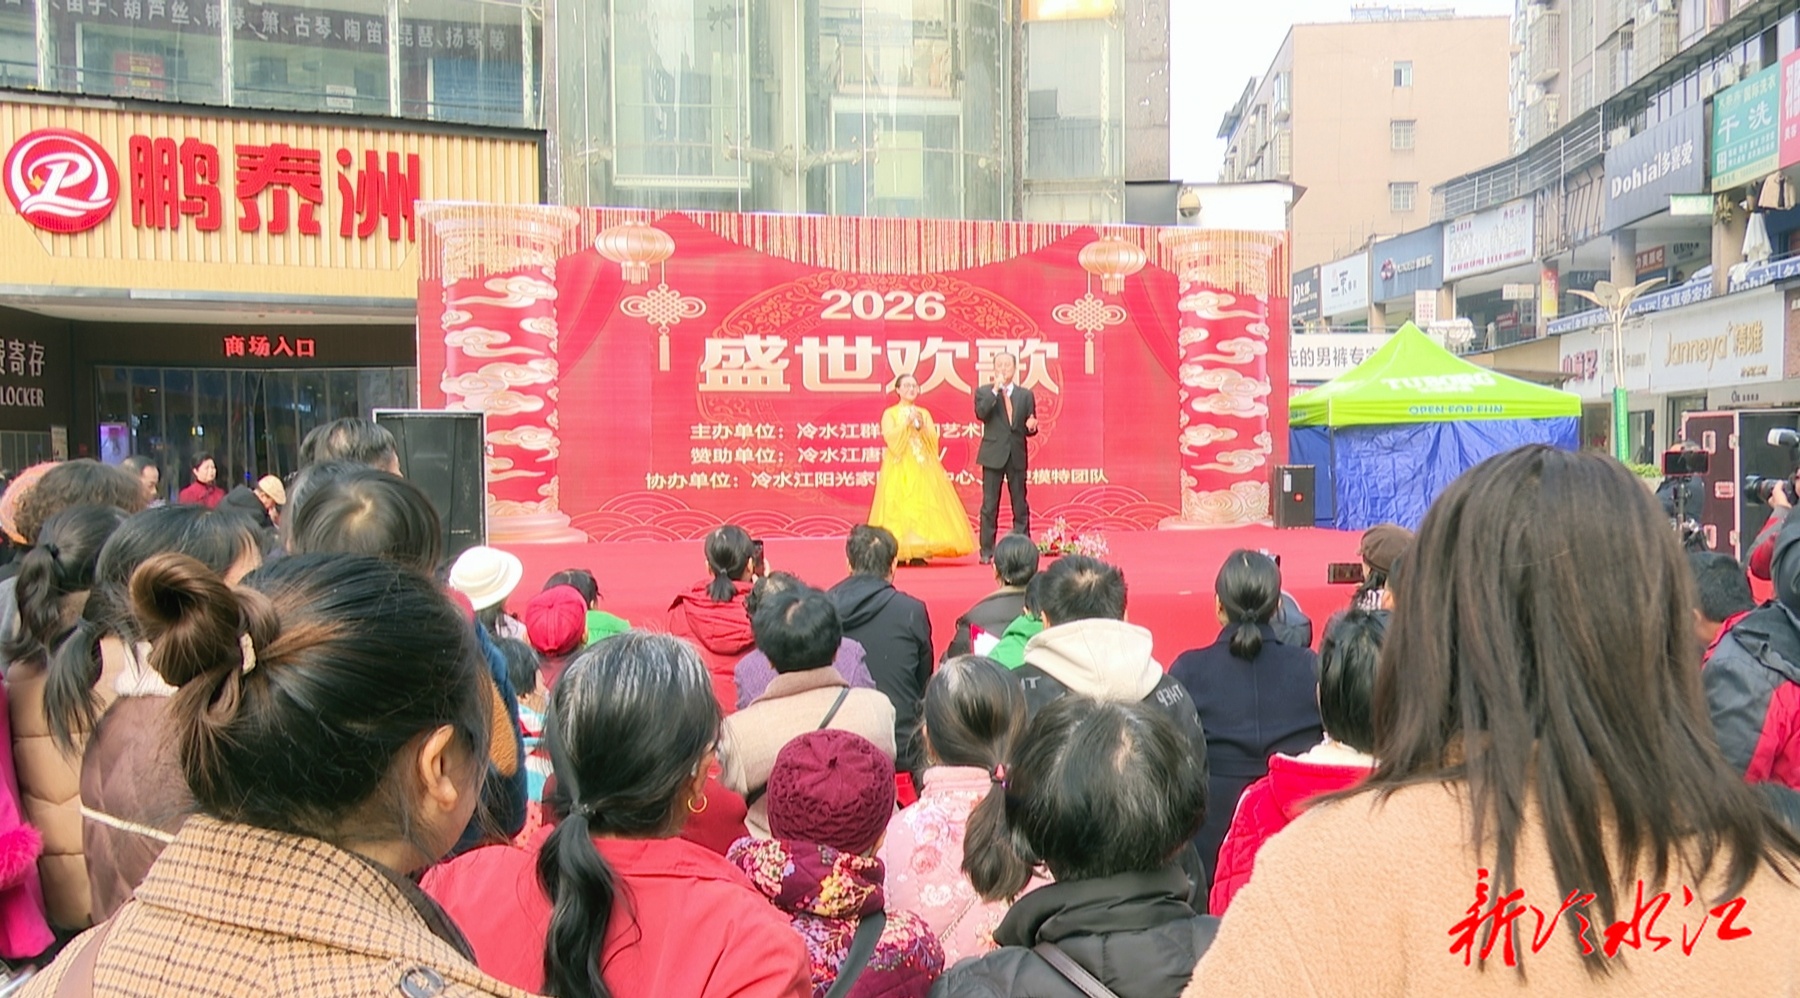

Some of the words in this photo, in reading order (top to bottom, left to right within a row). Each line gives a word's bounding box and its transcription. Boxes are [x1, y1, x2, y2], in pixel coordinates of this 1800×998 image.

[1717, 100, 1772, 143] 干洗
[1611, 160, 1659, 200] Dohia
[1661, 139, 1693, 177] 多喜爱
[129, 134, 420, 242] 鹏泰洲
[821, 289, 946, 321] 2026
[224, 335, 315, 358] 商场入口
[698, 335, 1060, 395] 盛世欢歌
[1381, 372, 1496, 391] TUBORG
[0, 385, 45, 407] LOCKER
[1409, 405, 1445, 415] OPEN
[1448, 405, 1473, 413] FOR
[690, 422, 784, 440] 主办单位：
[690, 447, 784, 465] 赞助单位：
[645, 471, 739, 490] 协办单位：
